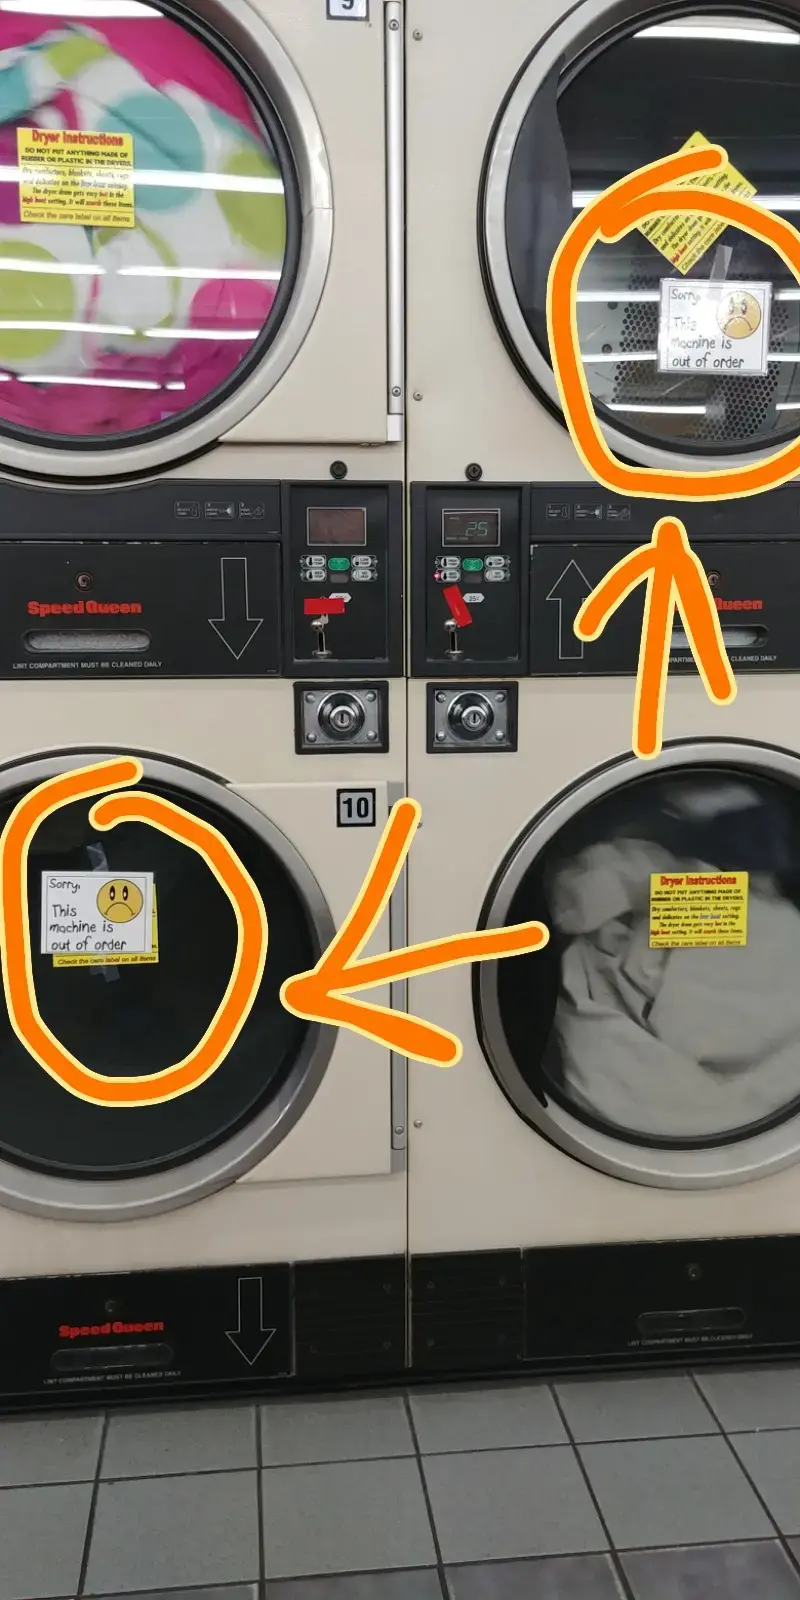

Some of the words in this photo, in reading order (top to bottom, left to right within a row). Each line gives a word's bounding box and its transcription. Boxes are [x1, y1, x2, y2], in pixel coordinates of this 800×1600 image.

[32, 130, 60, 145] Dryer
[63, 132, 124, 147] Instructions
[43, 188, 57, 196] dryer
[23, 210, 45, 218] Check
[75, 213, 91, 221] label
[671, 288, 701, 306] Sorry,
[721, 336, 733, 350] is
[672, 356, 691, 368] out
[695, 352, 711, 368] of
[713, 356, 745, 369] order
[27, 600, 85, 617] Speed
[85, 600, 143, 615] Queen
[714, 597, 763, 611] Queen
[29, 661, 79, 669] COMPARTMENT
[80, 661, 99, 669] MUST
[342, 797, 369, 818] 10
[49, 878, 81, 894] Sorry,
[660, 875, 684, 888] Dryer
[686, 874, 737, 885] Instructions
[52, 904, 77, 918] This
[49, 920, 97, 933] machine
[103, 920, 114, 933] is
[51, 940, 70, 951] out
[76, 935, 92, 951] of
[94, 939, 127, 951] order
[57, 957, 78, 965] Check
[59, 1322, 111, 1339] Speed
[112, 1321, 164, 1333] Queen
